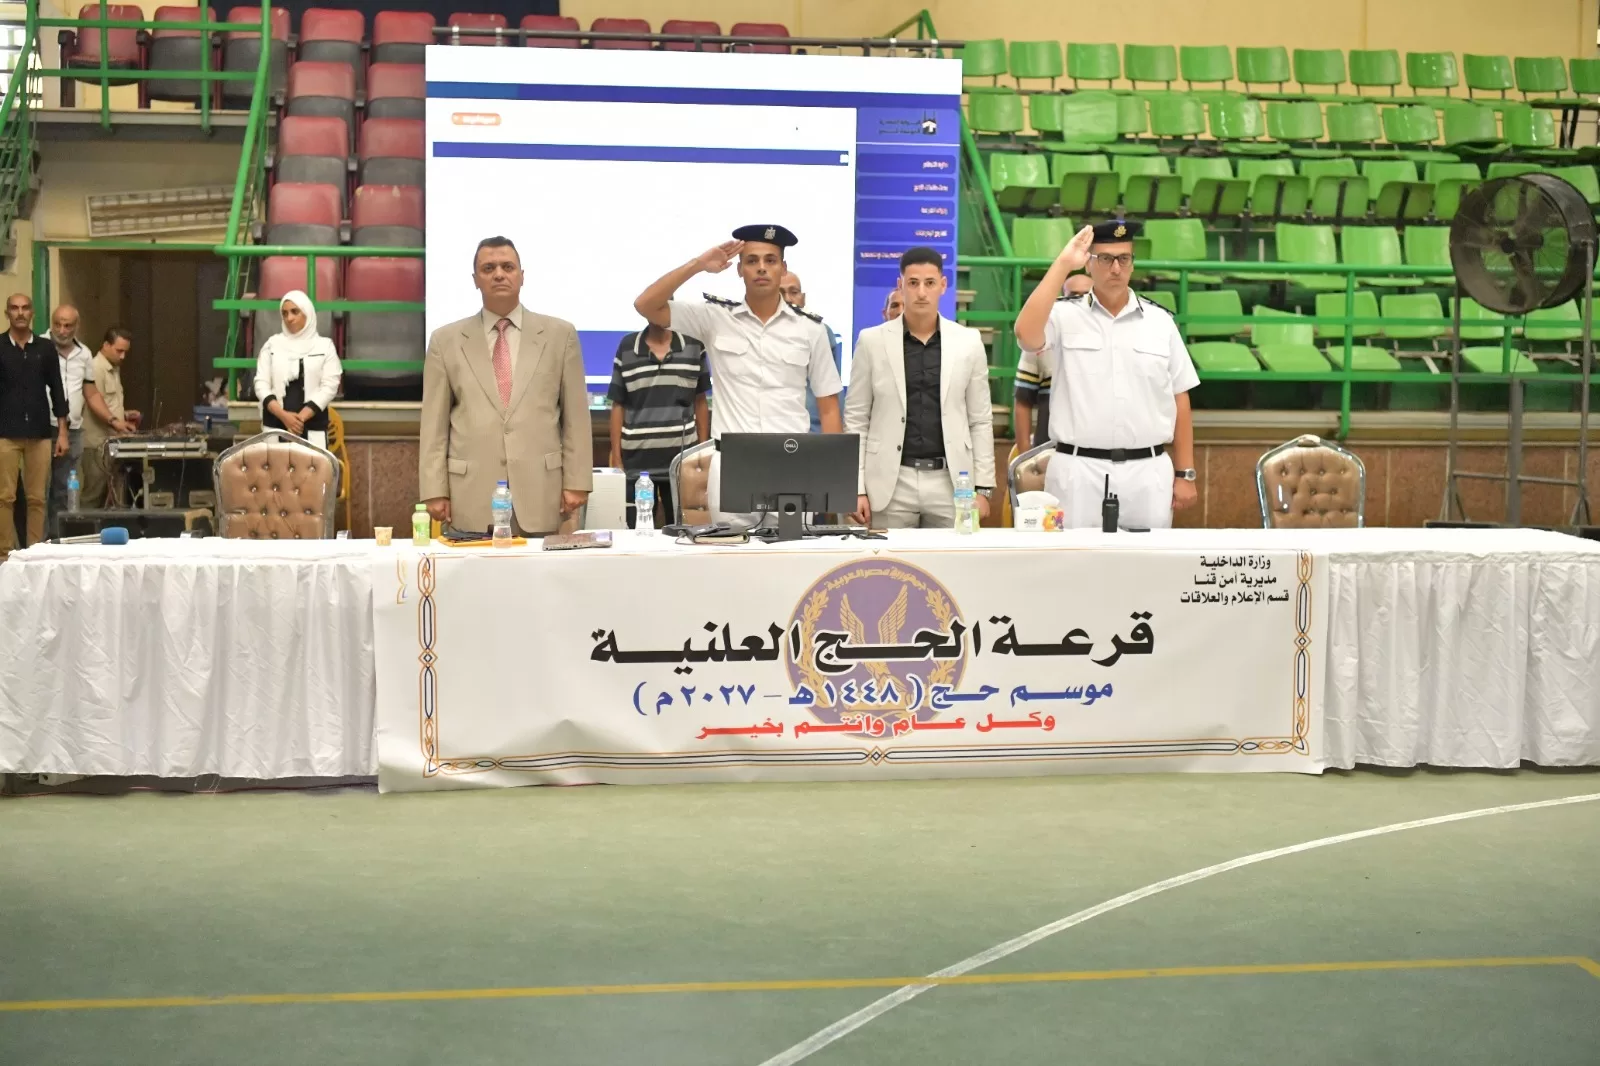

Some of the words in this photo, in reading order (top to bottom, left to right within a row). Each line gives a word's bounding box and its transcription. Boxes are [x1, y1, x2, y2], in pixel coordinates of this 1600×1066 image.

[1200, 555, 1247, 571] الداخلية
[1248, 555, 1271, 570] وزارة
[1194, 572, 1217, 586] قنا
[1240, 572, 1277, 588] مديرية
[1180, 591, 1229, 606] والعلاقات
[1231, 590, 1265, 606] الإعلام
[1267, 589, 1290, 604] قسم
[590, 620, 801, 676] العلنية
[814, 618, 982, 674] الحج
[988, 611, 1155, 668] قرعة
[930, 682, 1000, 710] حج
[1010, 681, 1114, 709] موسم
[695, 717, 785, 741] بخير
[794, 715, 886, 740] وانتم
[893, 713, 967, 737] عام
[975, 711, 1057, 733] وكل
